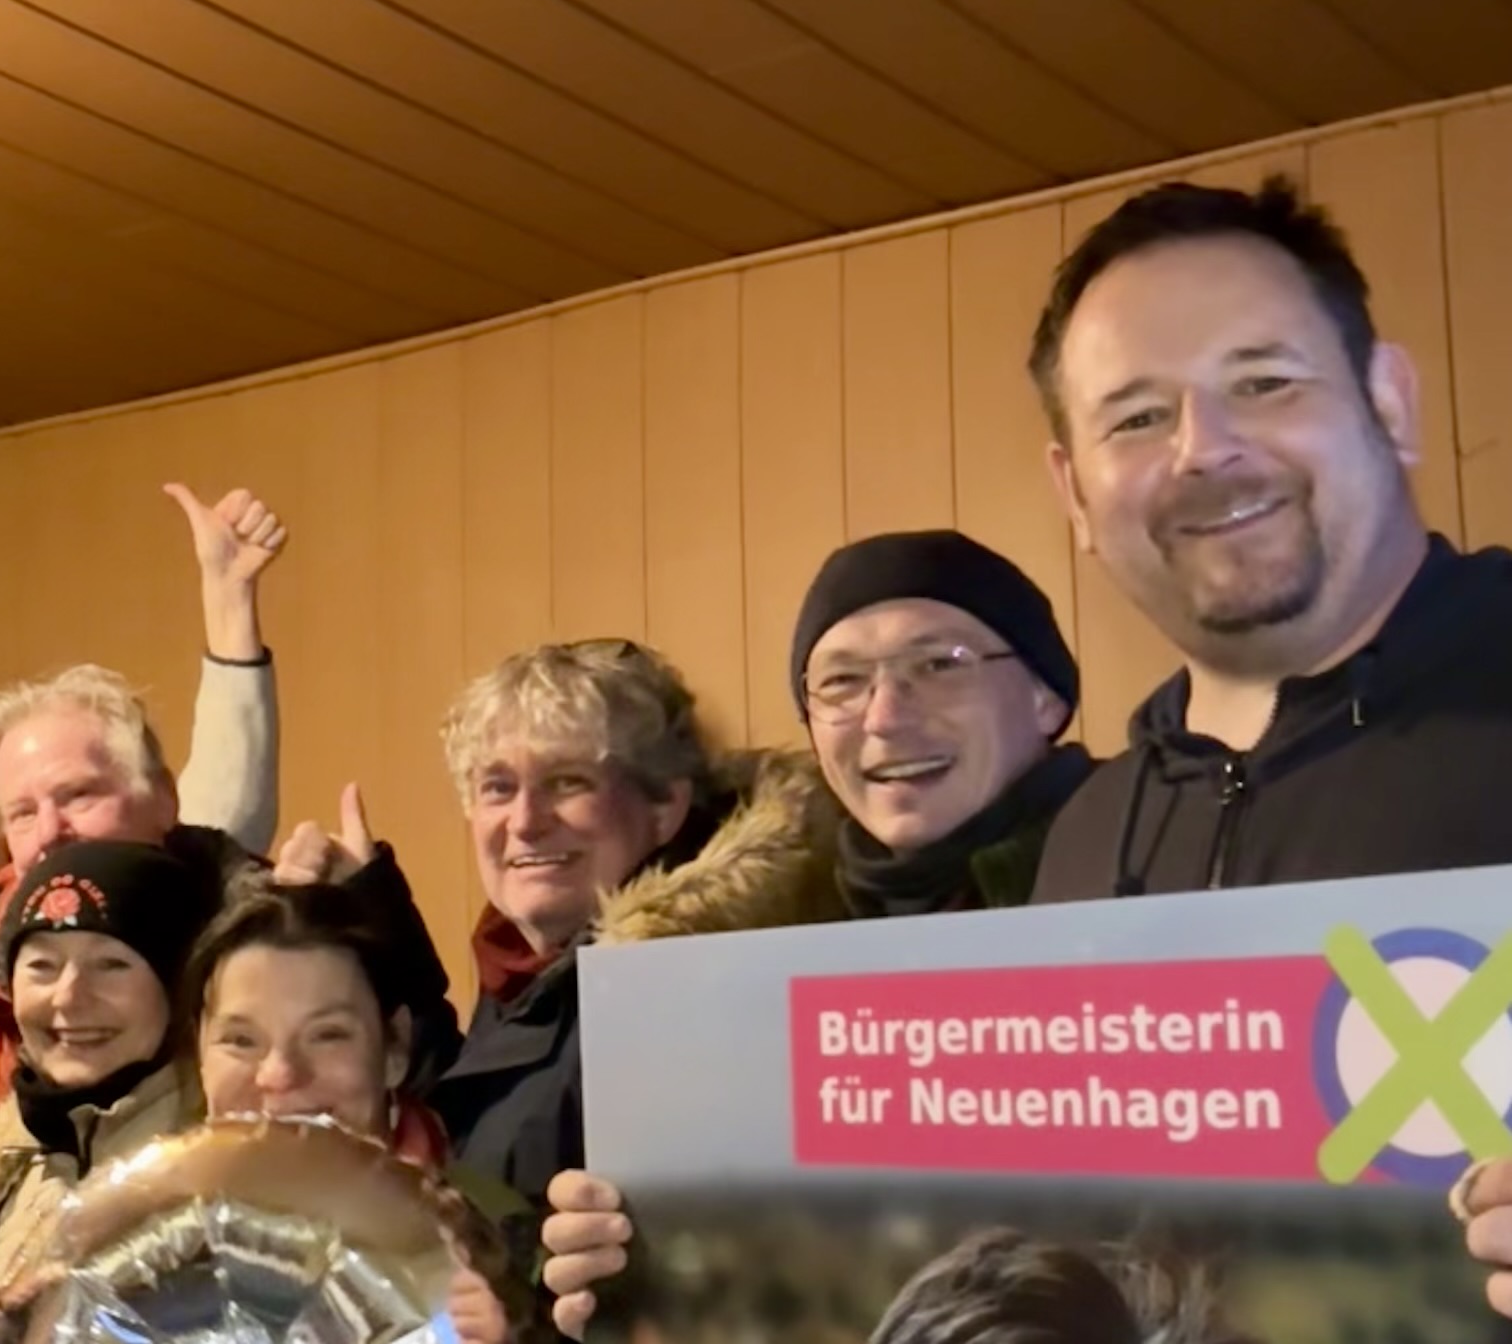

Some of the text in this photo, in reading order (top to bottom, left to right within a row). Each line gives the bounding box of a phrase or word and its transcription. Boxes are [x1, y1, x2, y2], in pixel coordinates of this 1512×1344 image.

[818, 998, 1285, 1066] Bürgermeisterin
[819, 1075, 1283, 1142] für Neuenhagen
